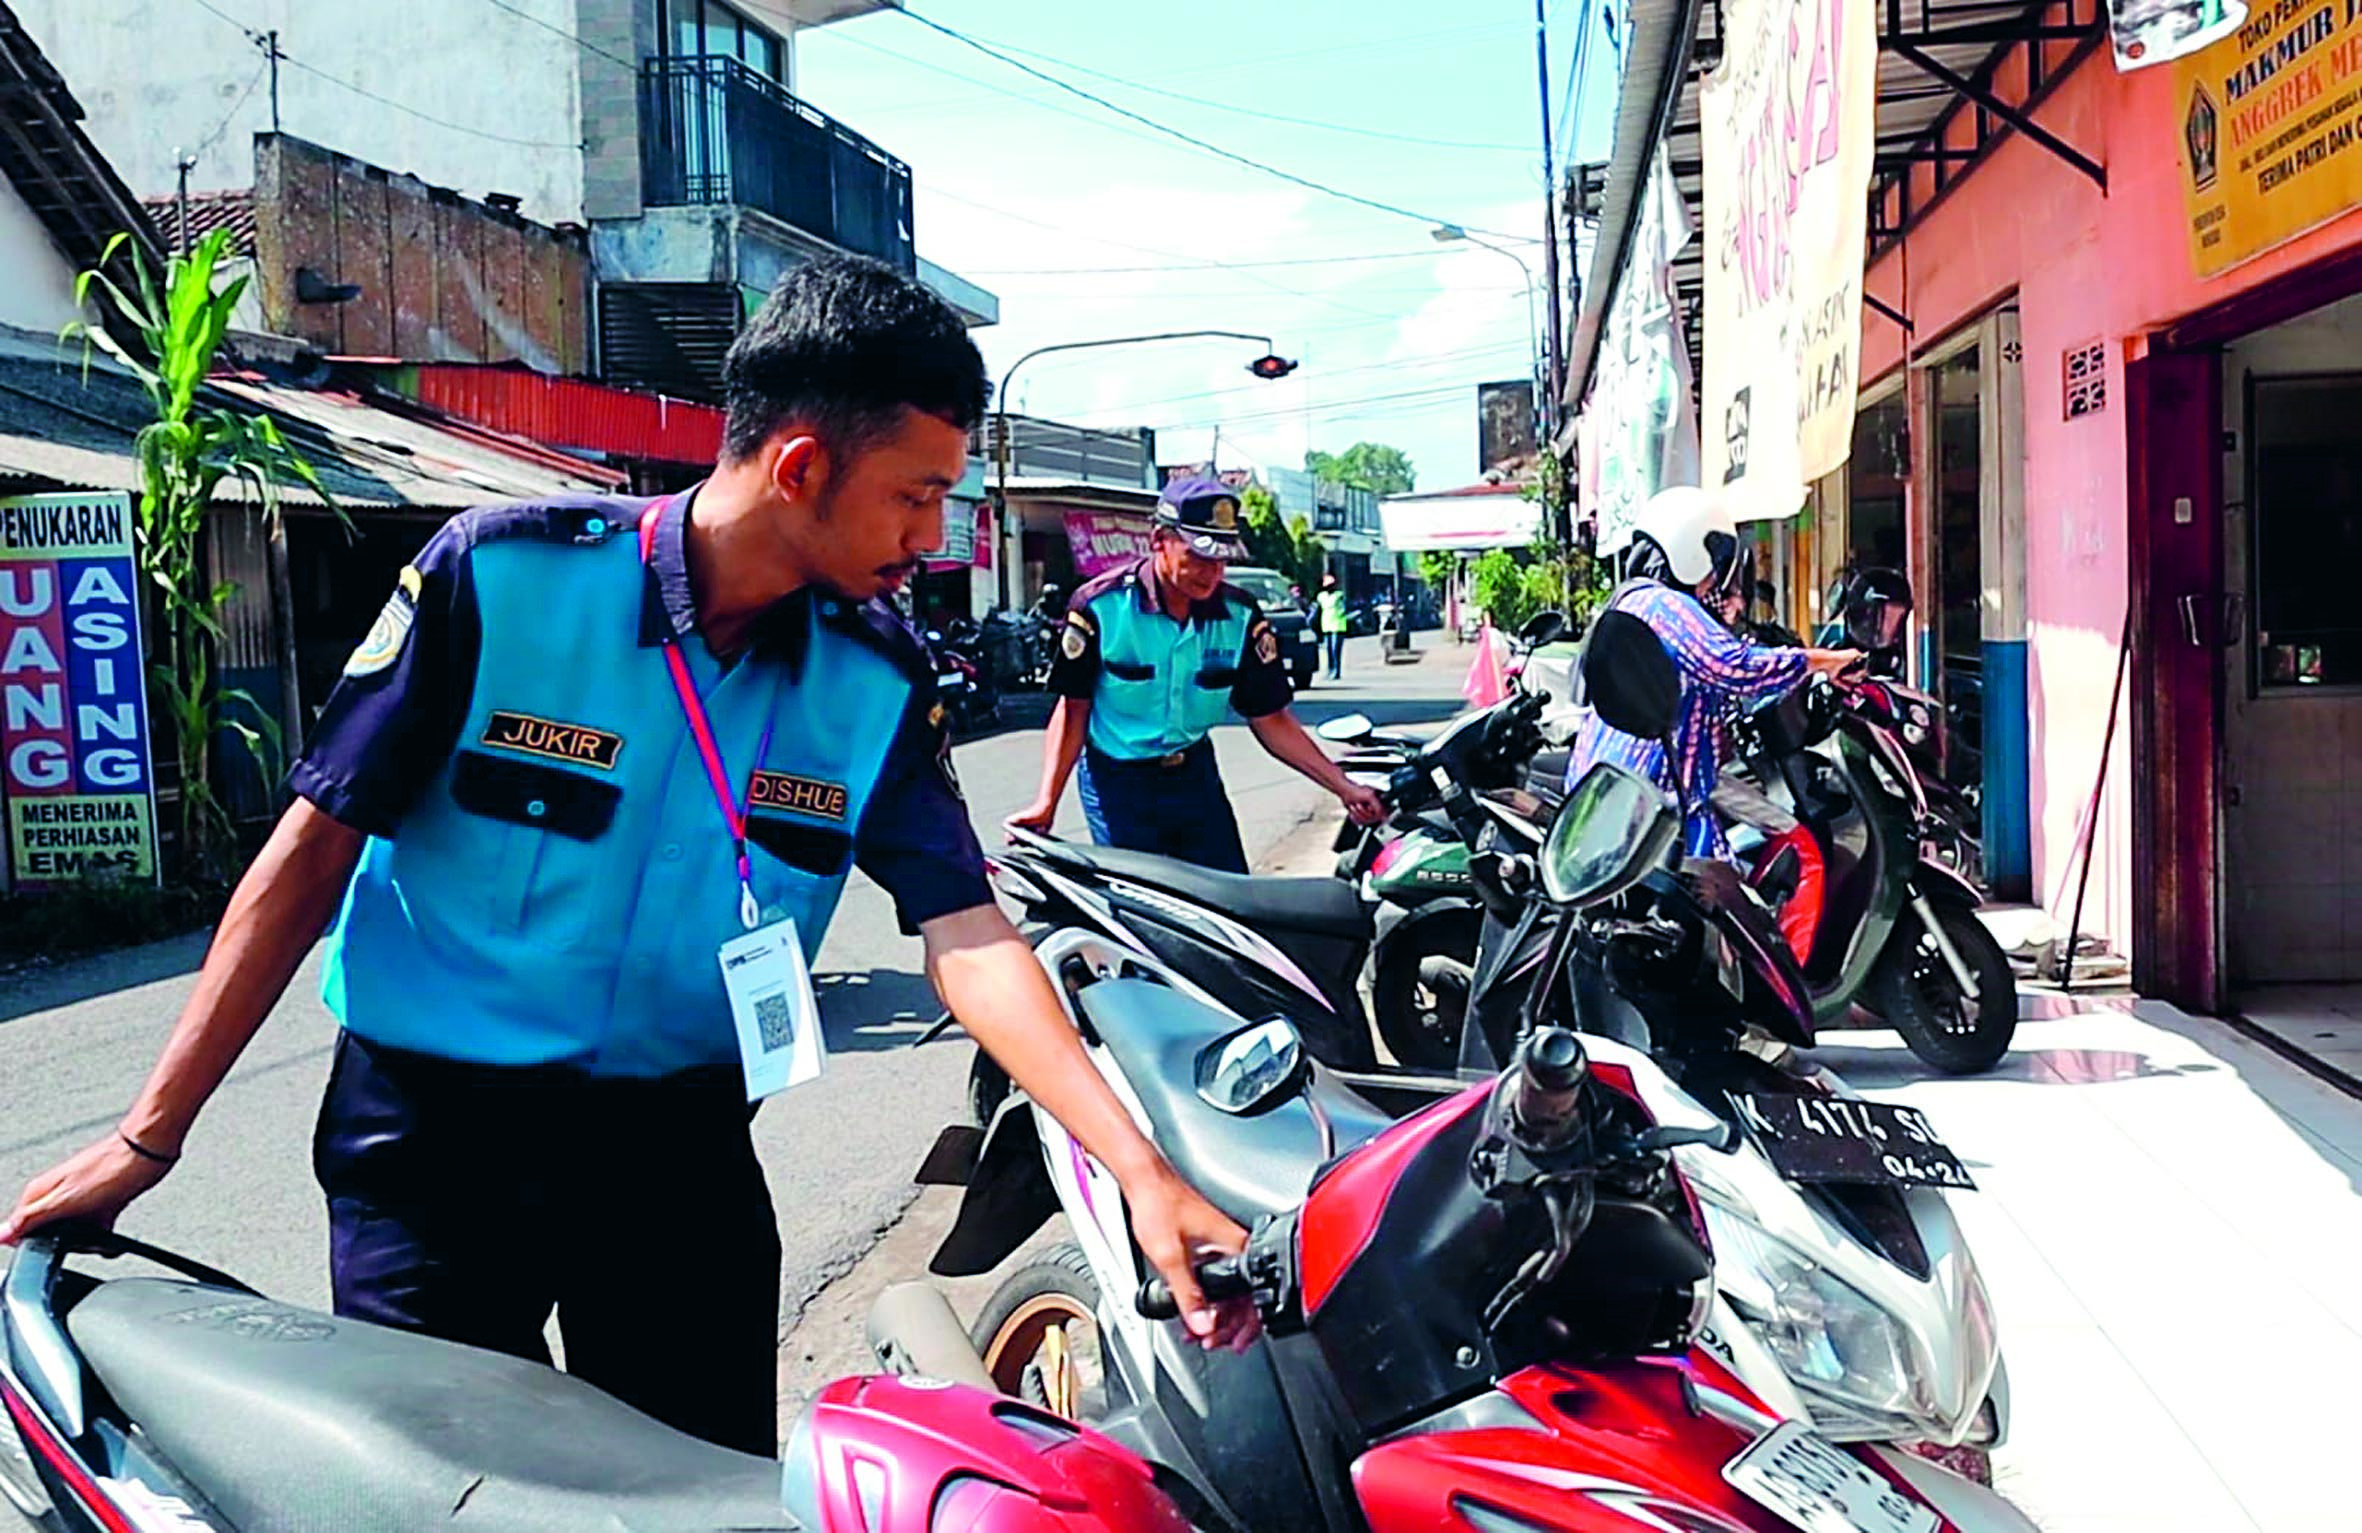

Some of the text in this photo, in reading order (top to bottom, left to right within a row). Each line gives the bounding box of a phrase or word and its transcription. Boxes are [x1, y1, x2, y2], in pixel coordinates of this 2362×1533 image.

[2238, 10, 2271, 54] TOKO
[2225, 6, 2333, 106] MAKMUR
[2231, 60, 2323, 152] ANGGREK
[2258, 156, 2294, 195] TERIMA
[2296, 136, 2328, 174] PATRI
[2329, 118, 2354, 155] DAN
[0, 504, 122, 548] ENUKARAN
[0, 568, 70, 788] UANG
[68, 566, 141, 786] ASING
[503, 720, 602, 759] JUKIR
[22, 802, 137, 823] MENERIMA
[752, 777, 844, 813] DISHUB
[23, 826, 140, 847] PERHIASAN
[1733, 1093, 1775, 1133] K
